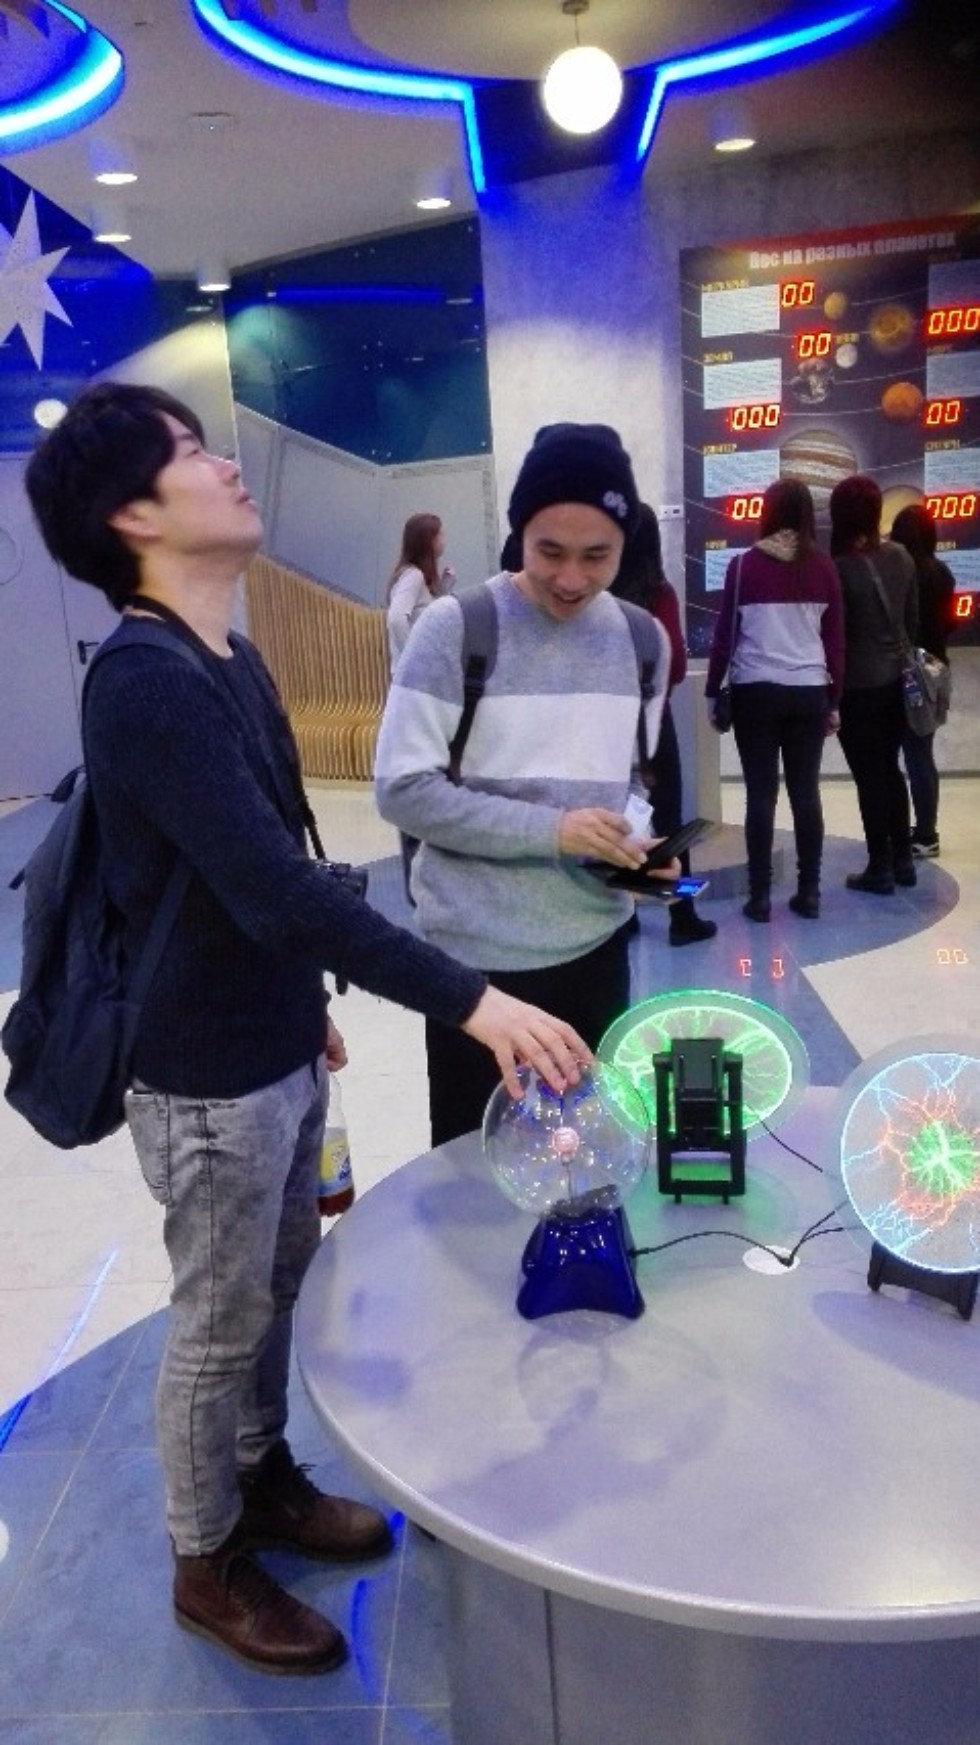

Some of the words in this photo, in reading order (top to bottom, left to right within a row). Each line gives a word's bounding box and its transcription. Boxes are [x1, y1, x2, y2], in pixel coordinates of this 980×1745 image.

[780, 281, 815, 308] 00
[928, 308, 980, 334] 000
[798, 332, 832, 358] 00
[732, 404, 781, 430] 000
[926, 400, 960, 425] 00
[731, 496, 764, 521] 00
